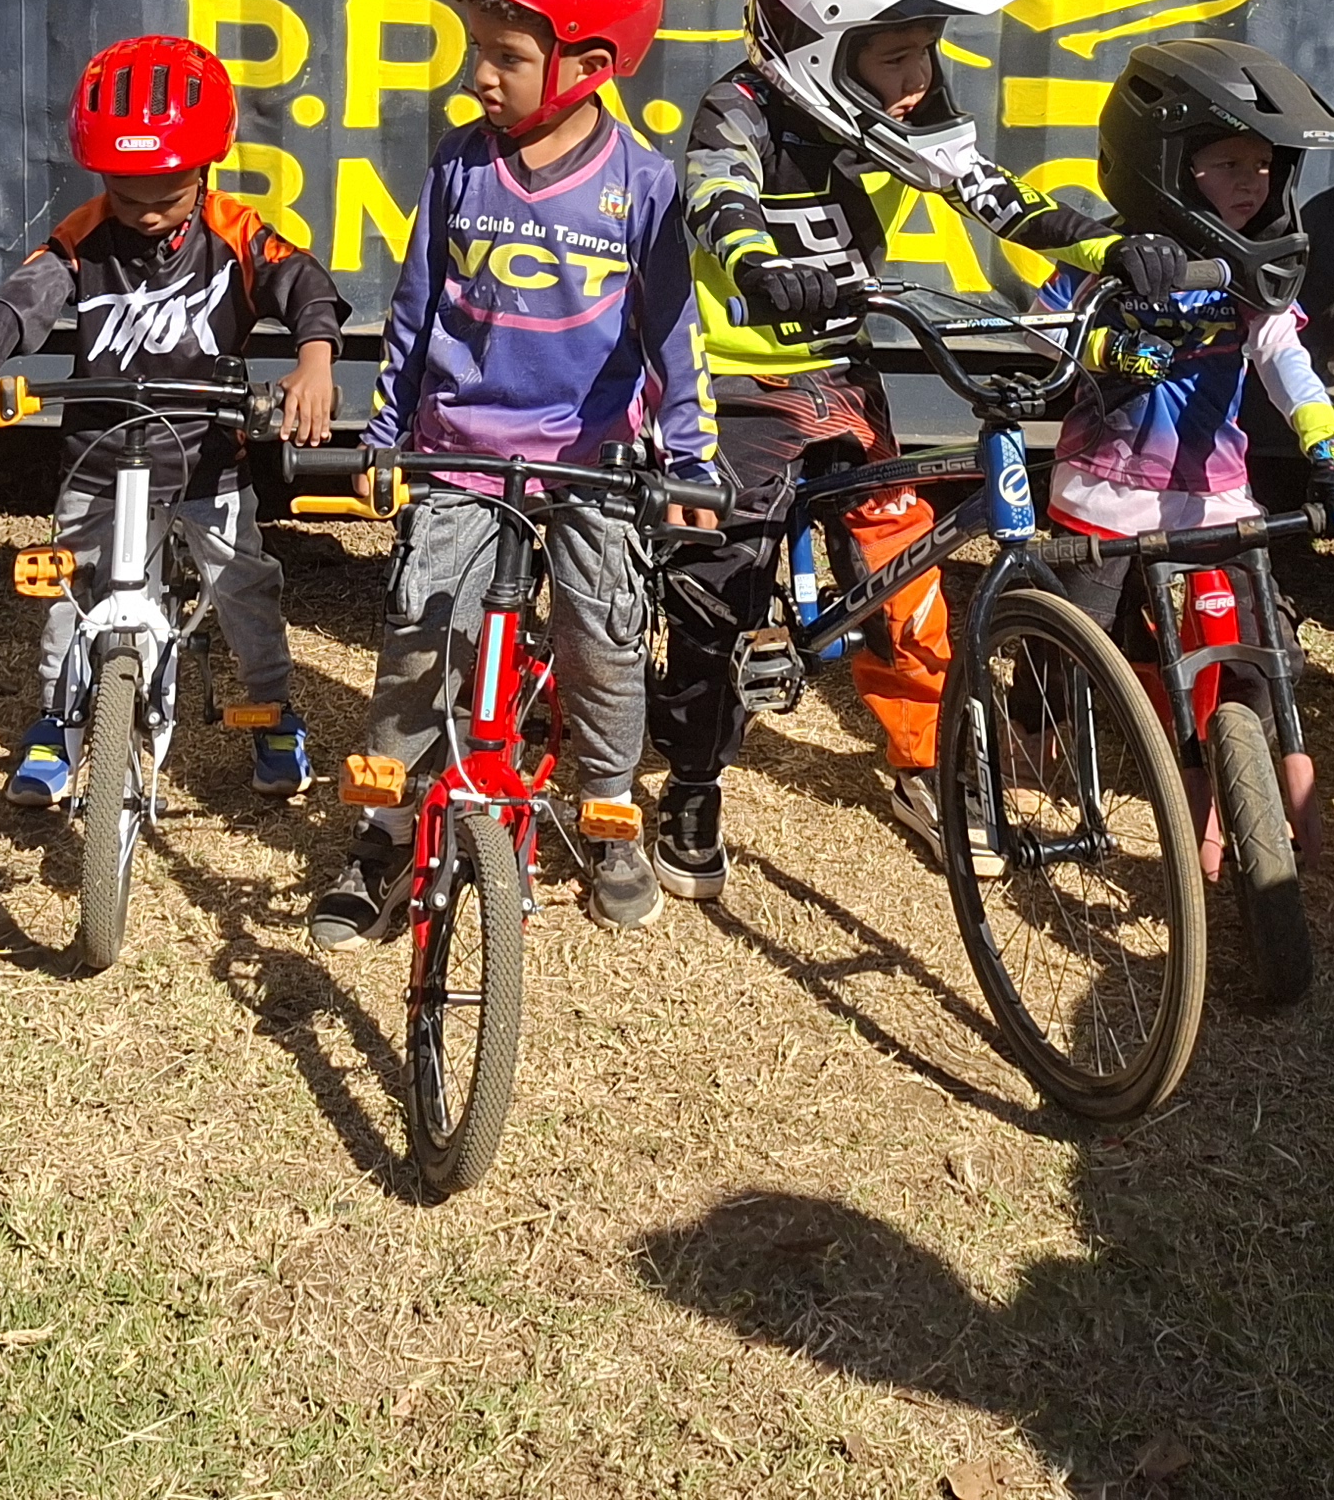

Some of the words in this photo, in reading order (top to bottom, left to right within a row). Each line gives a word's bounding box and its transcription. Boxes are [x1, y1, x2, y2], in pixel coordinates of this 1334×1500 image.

[1208, 104, 1251, 131] KENNY
[120, 138, 156, 149] ABUS
[476, 215, 515, 234] Club
[521, 219, 547, 238] du
[448, 236, 630, 297] VCT
[917, 456, 977, 476] EDGE
[1194, 594, 1236, 611] BERG
